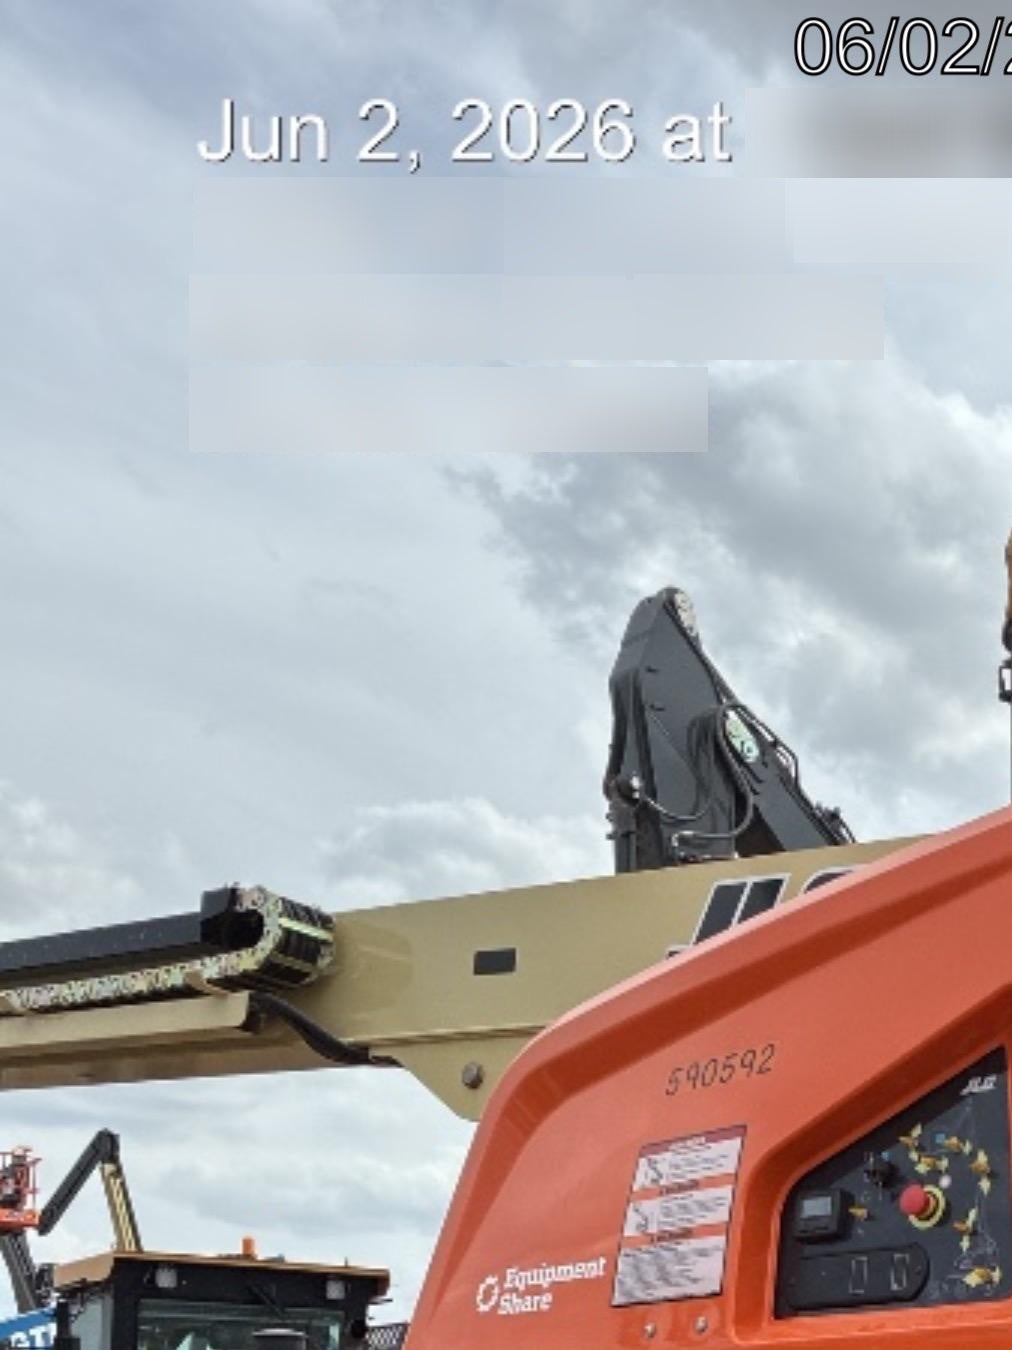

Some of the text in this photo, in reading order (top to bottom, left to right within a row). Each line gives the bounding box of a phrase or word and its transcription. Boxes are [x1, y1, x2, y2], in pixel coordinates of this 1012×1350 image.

[665, 1043, 776, 1096] 590592
[503, 1256, 606, 1291] Equipment
[498, 1292, 553, 1316] Share
